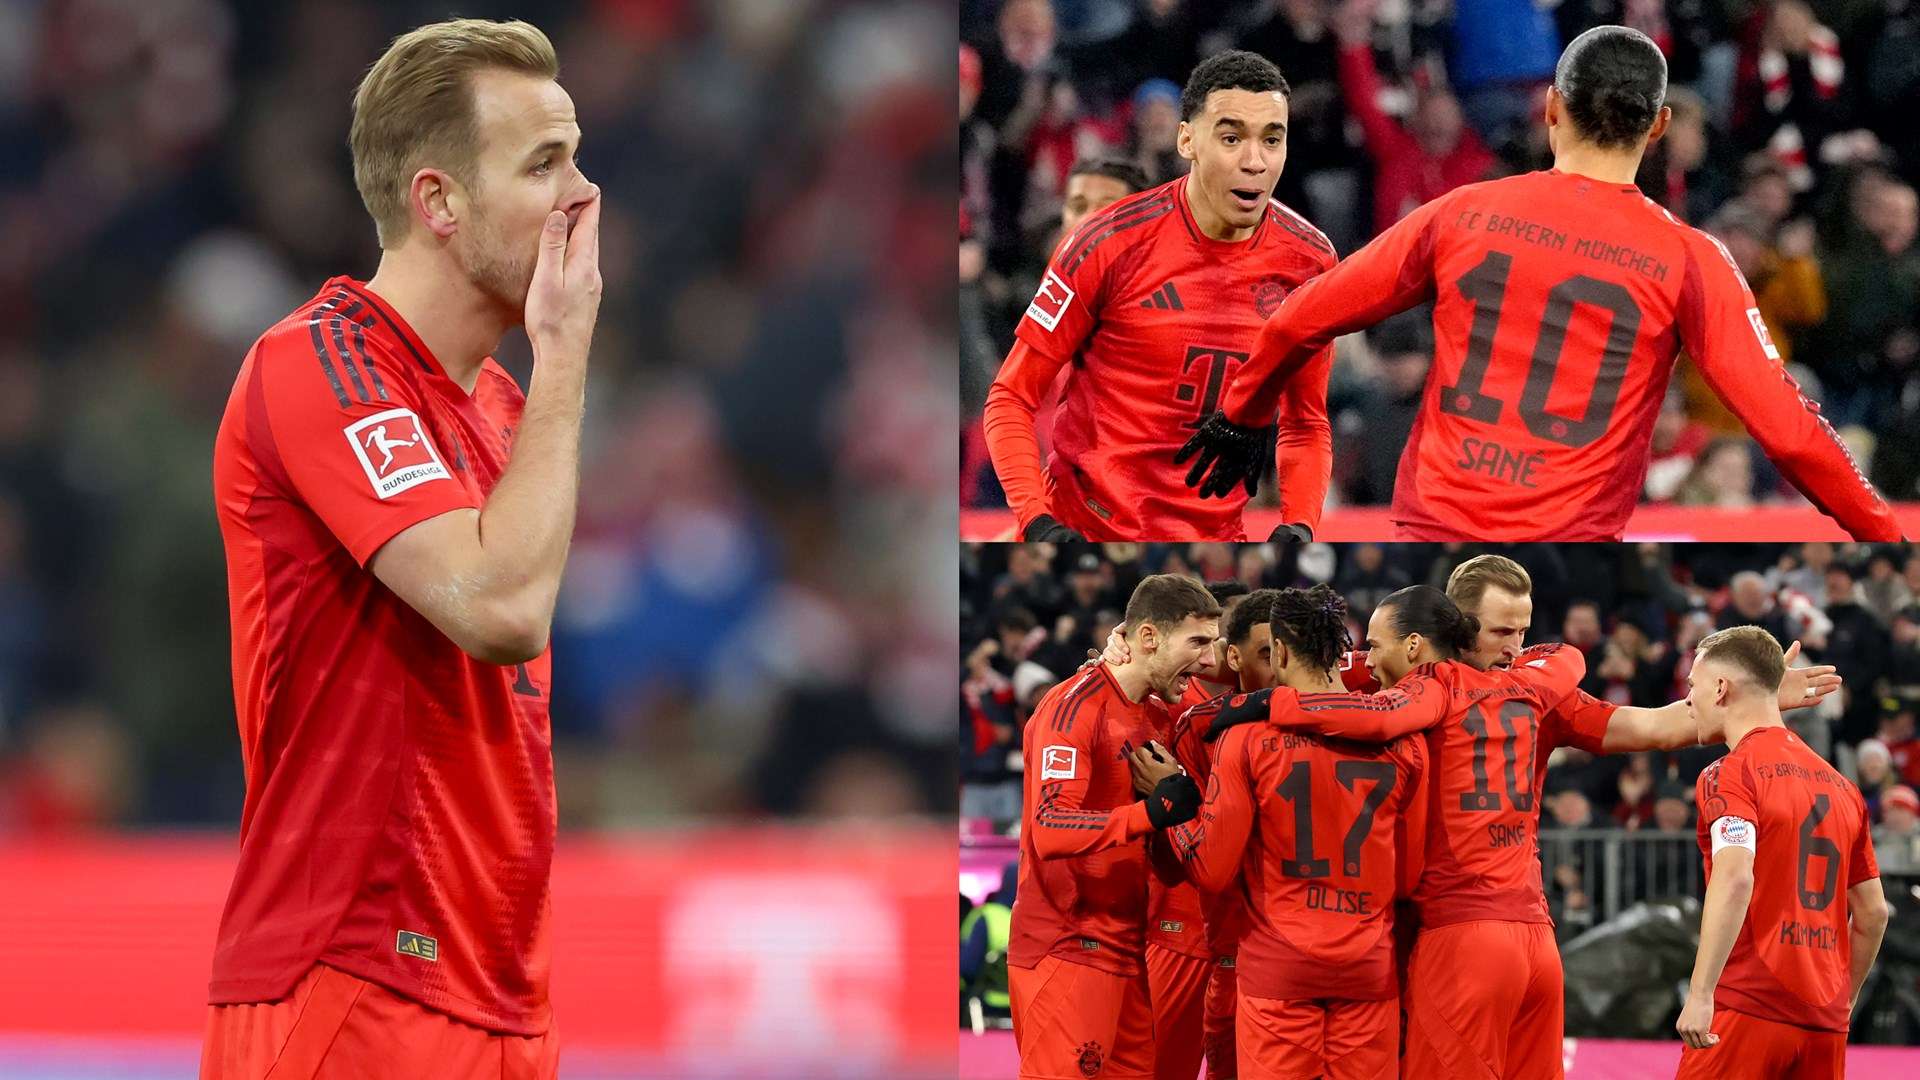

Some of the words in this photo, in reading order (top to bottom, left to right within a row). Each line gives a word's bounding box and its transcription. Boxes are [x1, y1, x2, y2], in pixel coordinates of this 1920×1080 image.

[1456, 211, 1482, 229] FC
[1486, 214, 1568, 250] BAYERN
[1573, 237, 1669, 283] MÜNCHEN
[1440, 249, 1643, 450] 10
[382, 466, 443, 492] BUNDESLIGA
[1457, 437, 1546, 489] SANÉ
[1262, 737, 1279, 752] FC
[1460, 701, 1537, 812] 10
[1757, 765, 1774, 780] FC
[1275, 760, 1397, 879] 17
[1797, 793, 1841, 912] 6
[1305, 884, 1373, 915] OLISE
